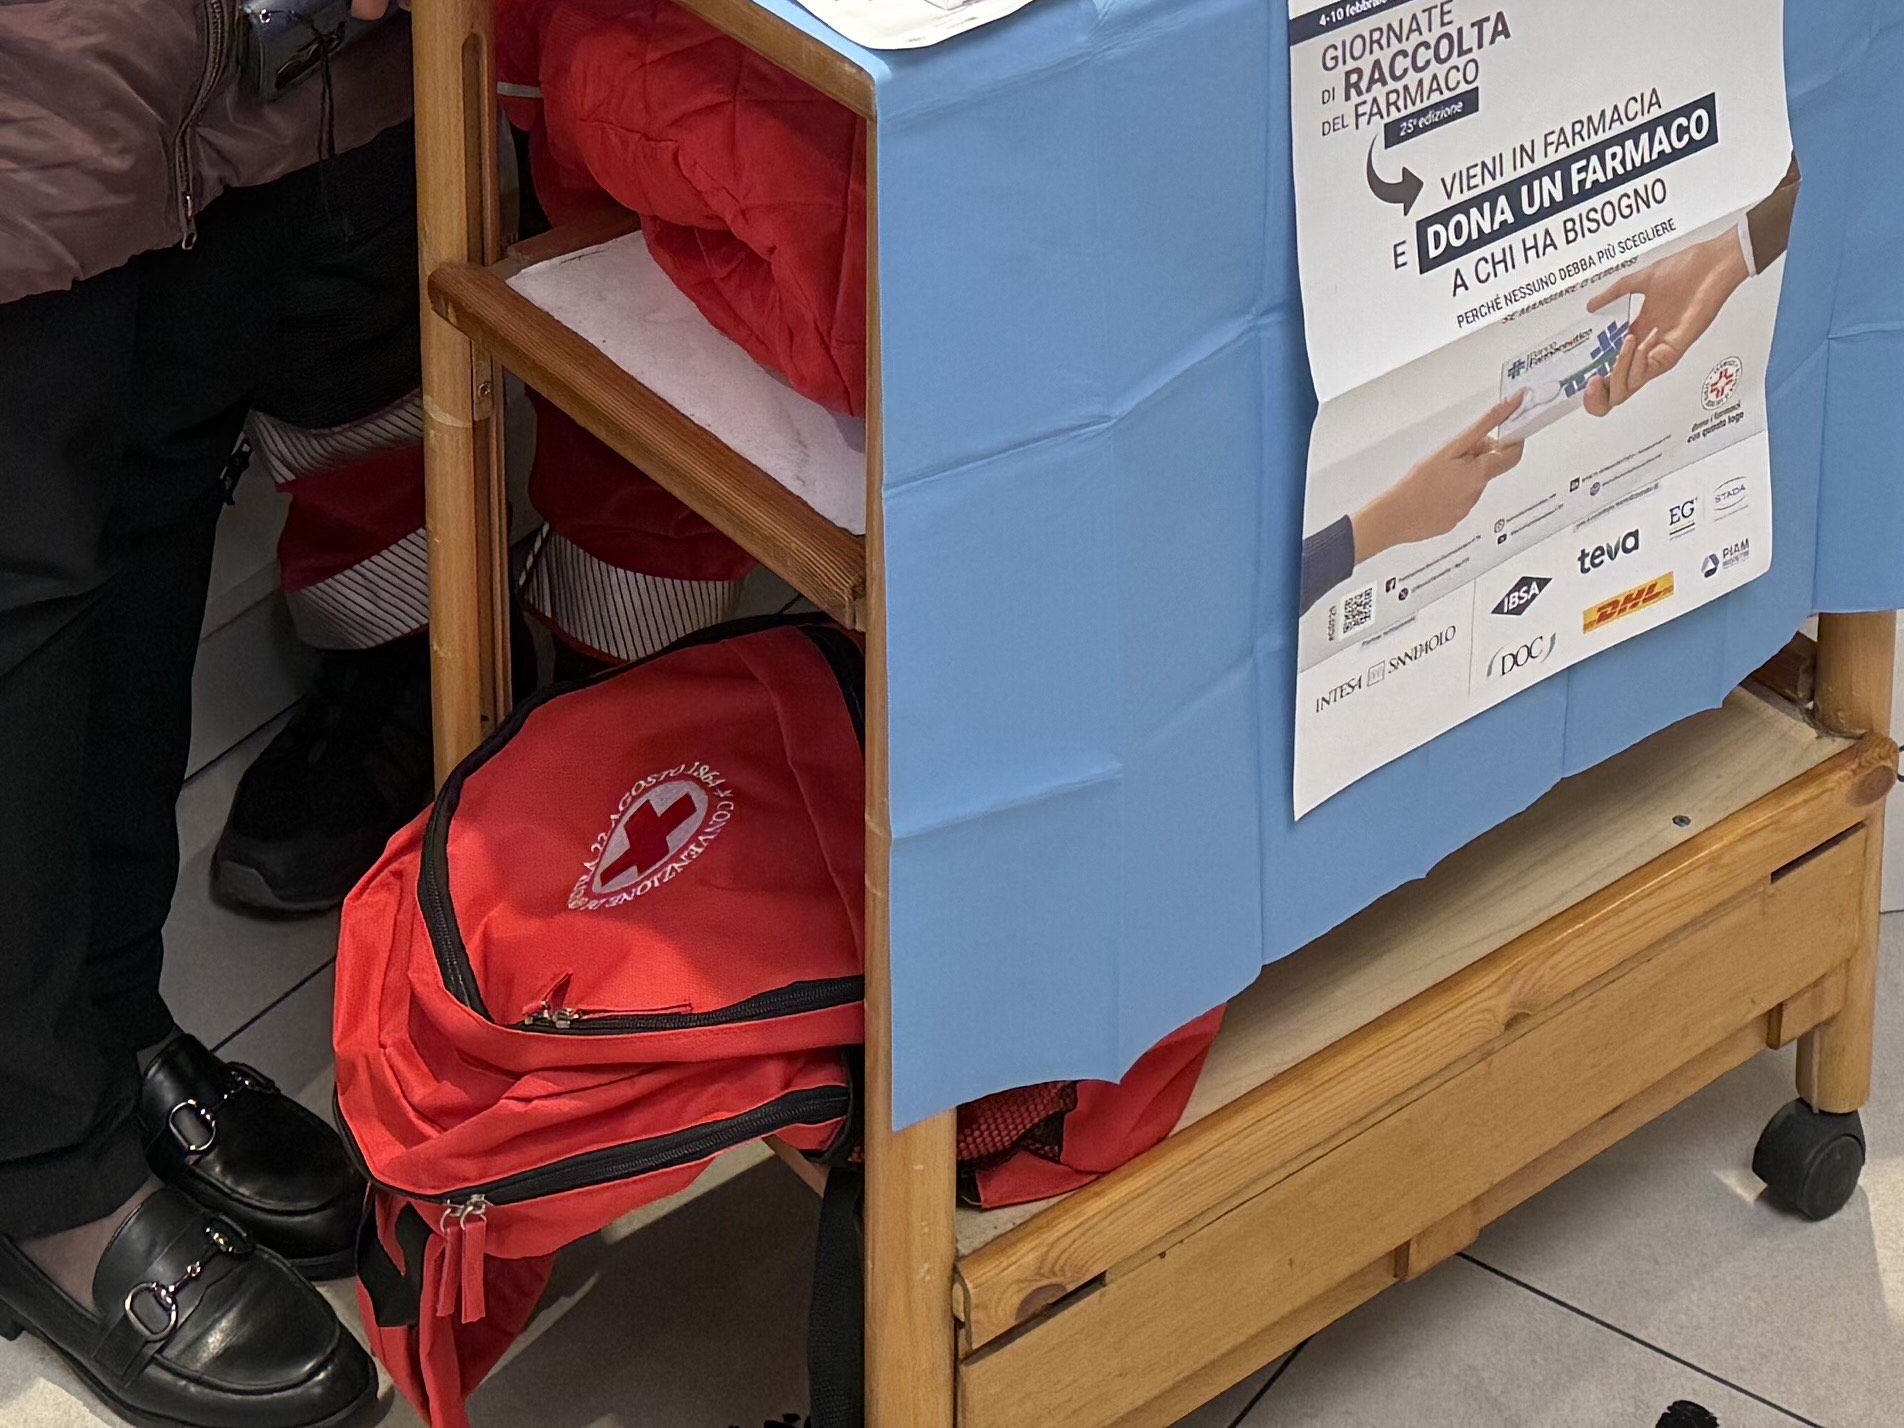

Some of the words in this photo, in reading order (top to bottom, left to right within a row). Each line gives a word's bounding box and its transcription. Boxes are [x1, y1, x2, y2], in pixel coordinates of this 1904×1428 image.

[1321, 0, 1454, 72] GIORNATE
[1321, 87, 1336, 105] DI
[1343, 10, 1511, 102] RACCOLTA
[1321, 115, 1349, 136] DEL
[1354, 58, 1480, 130] FARMACO
[1440, 159, 1505, 201] VIENI
[1511, 148, 1536, 172] IN
[1542, 87, 1661, 157] FARMACIA
[1393, 240, 1407, 269] E
[1425, 195, 1514, 259] DONA
[1520, 177, 1563, 215] UN
[1570, 108, 1710, 195] FARMACO
[1474, 248, 1515, 285] CHI
[1521, 235, 1557, 266] HA
[1563, 176, 1667, 246] BISOGNO
[1457, 293, 1501, 328] PERCHÉ
[1504, 270, 1556, 313] NESSUNO
[1558, 252, 1595, 284] DEBBA
[1598, 241, 1615, 266] PIÙ
[1618, 217, 1676, 258] SCEGLIERE
[1577, 528, 1639, 574] teva
[1503, 582, 1540, 612] IBSA
[1596, 583, 1661, 624] DHL
[1501, 635, 1545, 676] DOC
[1315, 676, 1362, 713] INTESA
